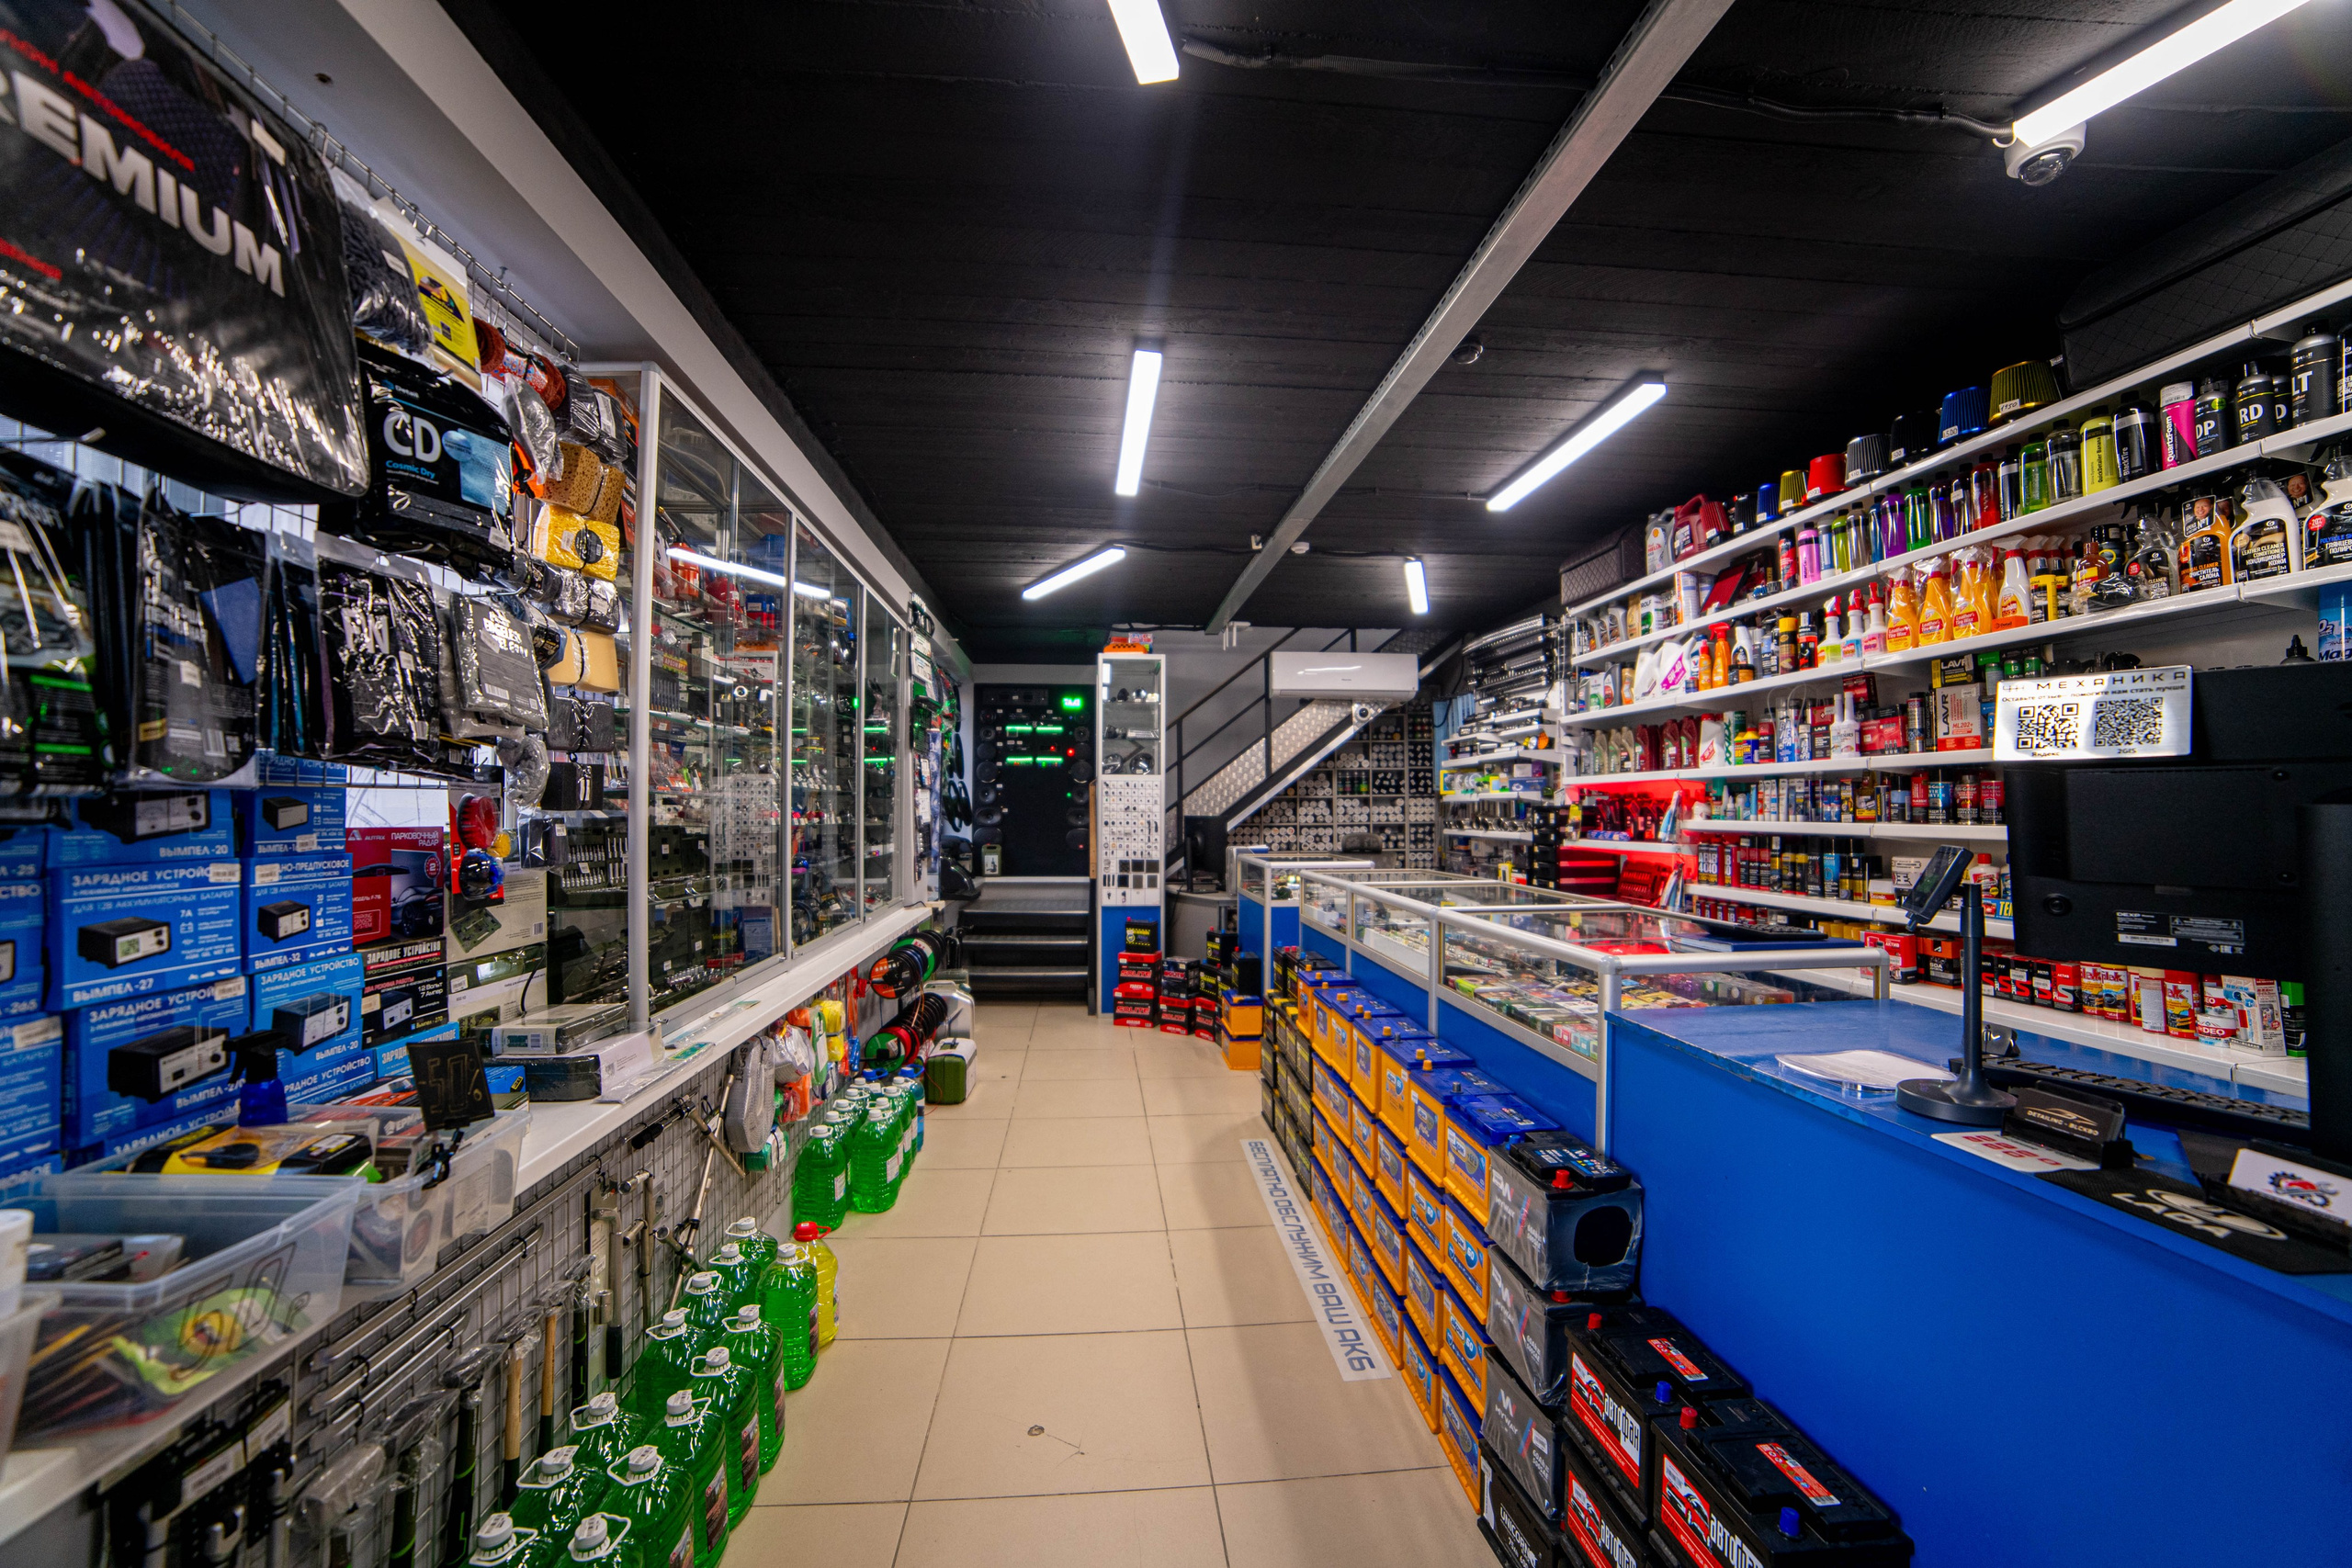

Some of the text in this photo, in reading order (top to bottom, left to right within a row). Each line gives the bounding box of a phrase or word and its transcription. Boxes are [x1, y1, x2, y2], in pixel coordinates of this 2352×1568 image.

[2291, 370, 2313, 396] LT
[2239, 403, 2264, 423] RD
[383, 411, 441, 463] CD
[2165, 415, 2174, 462] QuartzFoam
[2195, 420, 2216, 440] DP
[386, 459, 419, 473] Cosmic
[420, 467, 435, 479] Dry
[2121, 446, 2130, 476] BlackTire
[2242, 542, 2285, 557] LEATHER CLEANER
[2245, 553, 2286, 566] КОНДИЦИОНЕР
[2253, 547, 2286, 558] CONDITIONER
[2268, 558, 2287, 567] КОЖИ
[2036, 671, 2187, 691] МЕХАНИКА
[2155, 683, 2186, 693] лучше
[1941, 694, 1951, 736] LAVR
[1952, 721, 1973, 729] ML202+
[391, 831, 439, 840] ПАРКОВОЧНЫЙ
[418, 839, 439, 847] РАДАР
[429, 863, 436, 872] 2
[72, 871, 149, 887] ЗАРЯДНОЕ
[368, 947, 401, 964] ЗАРЯДНОЕ
[402, 941, 441, 957] УСТРОЙСТВО
[1885, 941, 1900, 949] АКТИВ
[261, 967, 306, 986] ЗАРЯДНОЕ
[310, 957, 359, 975] УСТРОЙСТВО
[89, 987, 216, 1023] ЗАРЯДНОЕ УСТРОЙ
[285, 1056, 371, 1093] РЯДНОЕ УСТРОЙСТВО
[2027, 1110, 2064, 1126] DETAILING
[2112, 1192, 2233, 1239] LADA
[1248, 1141, 1376, 1371] БЕСПЛАТНО ОБСЛУЖИМ ВАШ АКБ
